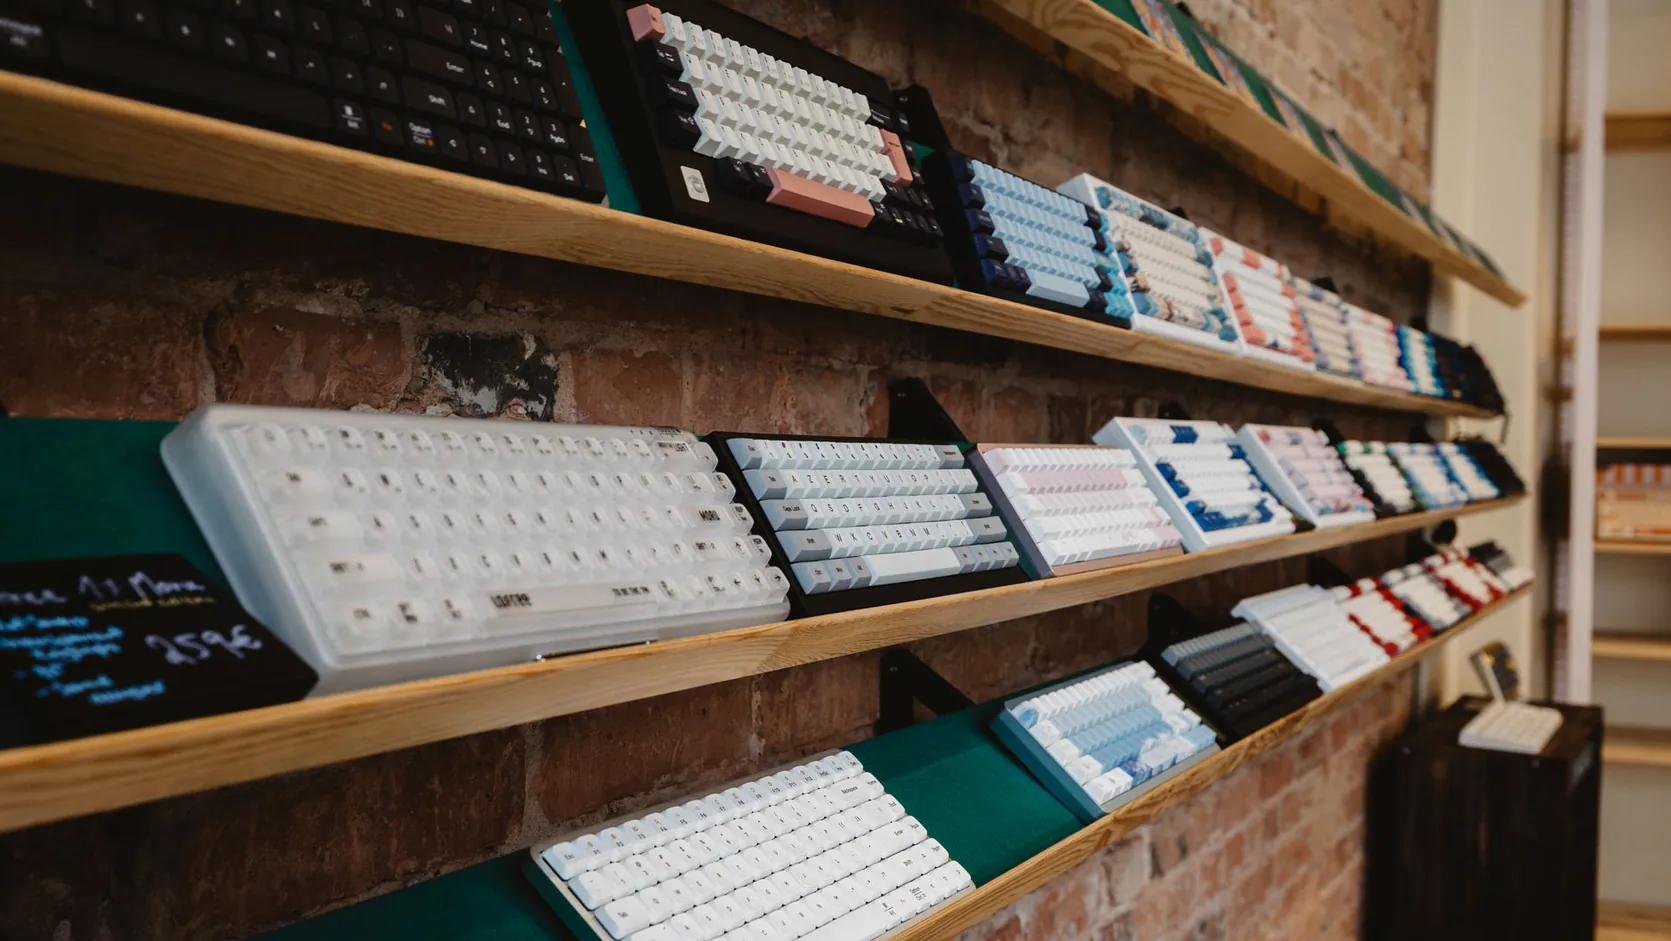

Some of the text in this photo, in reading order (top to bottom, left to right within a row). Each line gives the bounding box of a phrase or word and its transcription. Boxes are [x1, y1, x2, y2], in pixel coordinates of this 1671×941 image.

[446, 61, 464, 73] Enter
[428, 94, 446, 106] Shift
[580, 153, 594, 163] Enter
[792, 475, 798, 483] A
[807, 475, 814, 483] Z
[824, 475, 831, 484] E
[840, 474, 846, 483] R
[811, 504, 818, 513] Q
[827, 504, 834, 512] S
[843, 504, 849, 512] D
[858, 504, 863, 512] F
[874, 502, 880, 511] G
[851, 532, 858, 541] X
[866, 532, 873, 540] C
[881, 531, 888, 539] V
[895, 530, 902, 538] B
[910, 528, 917, 537] N
[923, 528, 930, 536] M
[835, 533, 843, 543] W
